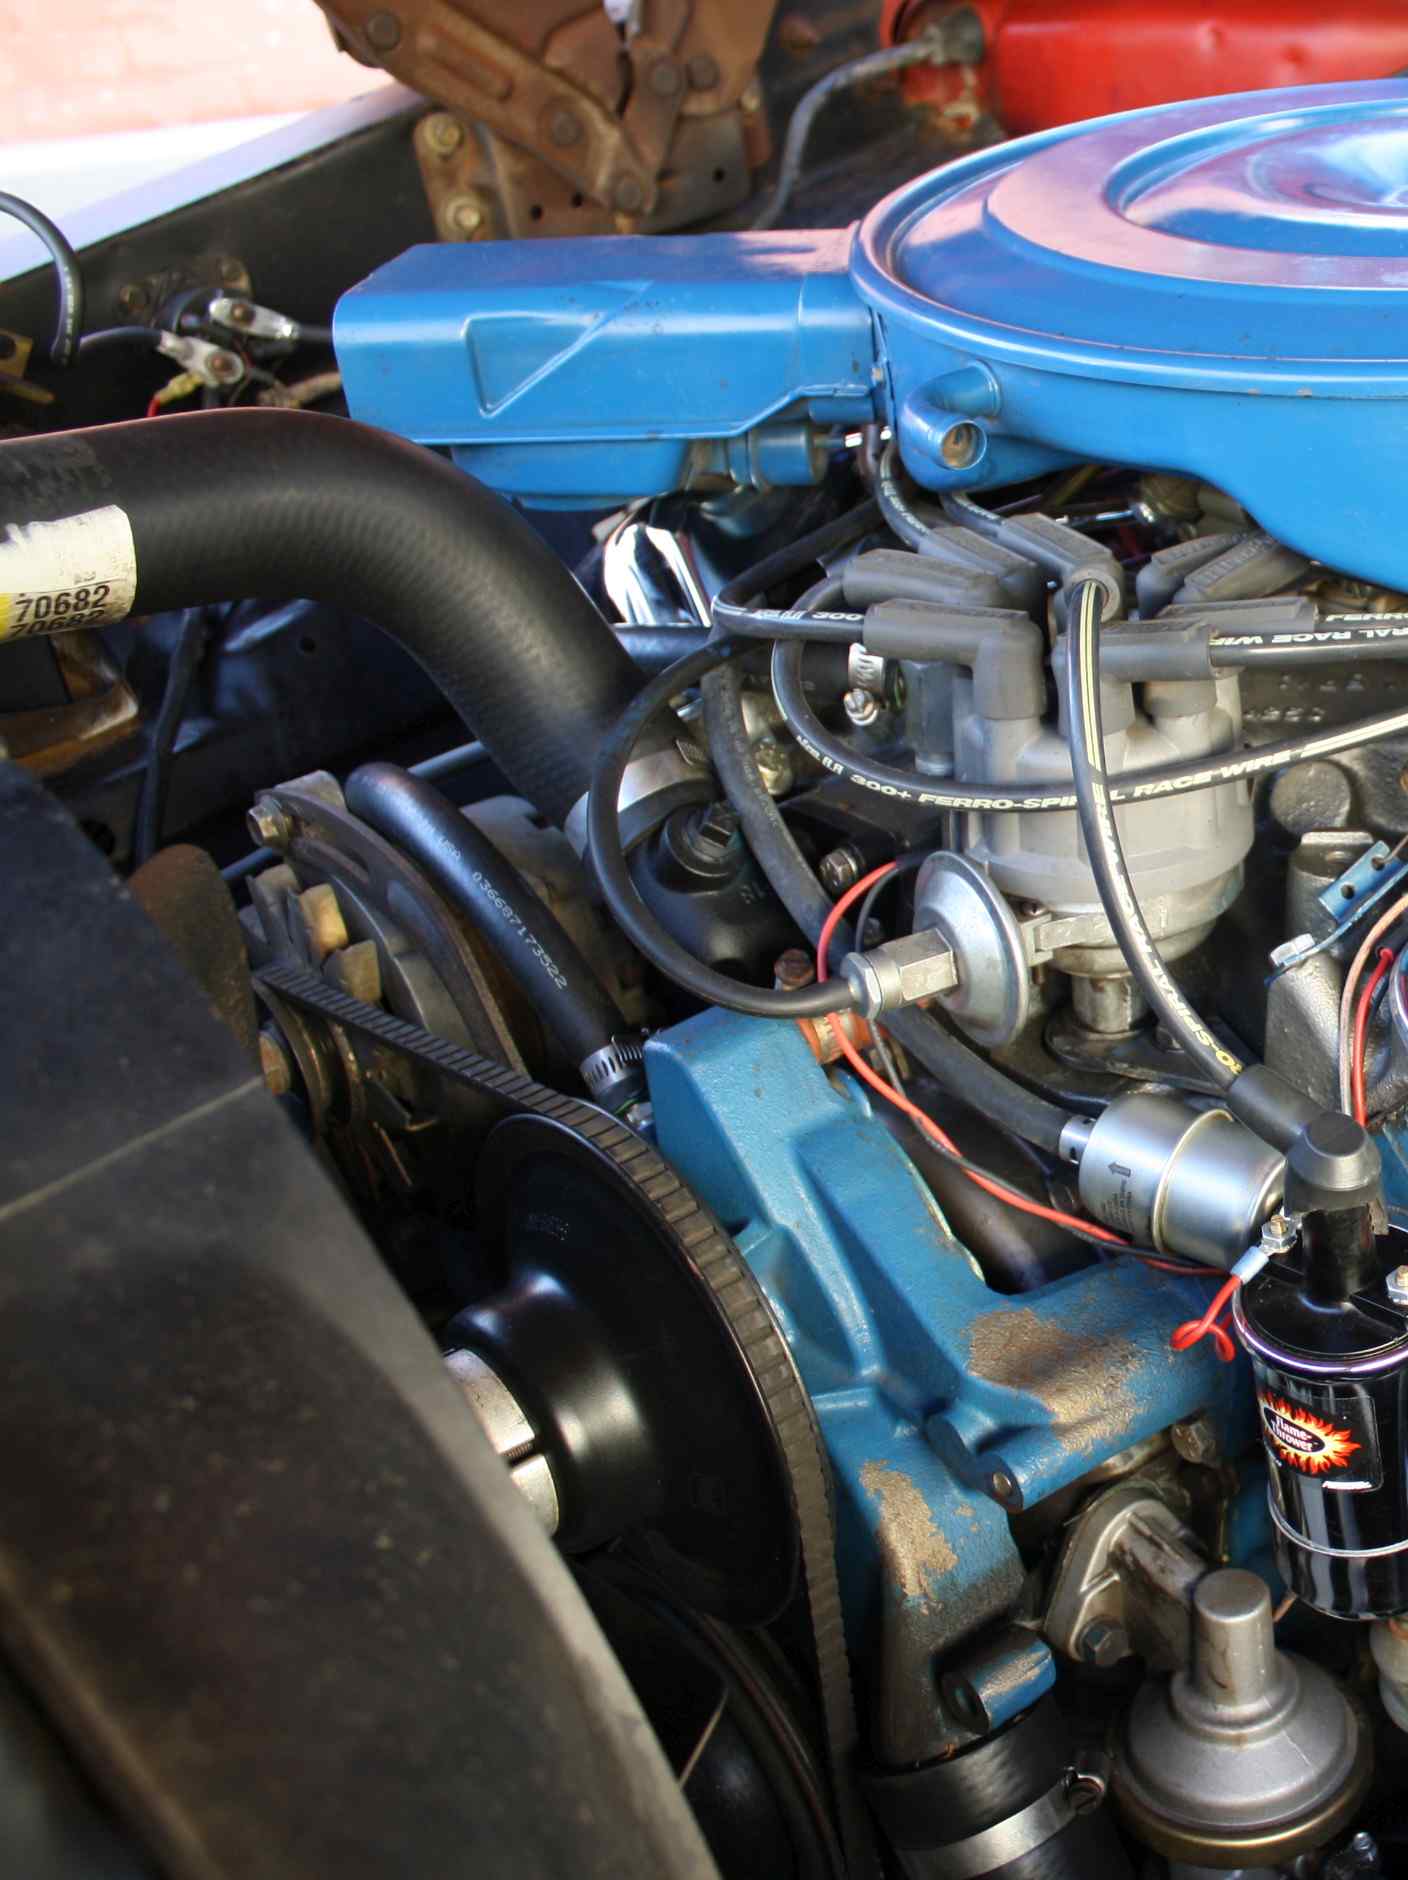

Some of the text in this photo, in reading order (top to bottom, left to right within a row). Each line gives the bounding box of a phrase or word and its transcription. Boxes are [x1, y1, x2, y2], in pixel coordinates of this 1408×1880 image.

[15, 584, 110, 622] 70682
[1271, 632, 1351, 644] RACE
[850, 750, 1291, 809] 300+ FERRO-SPIL RACE WIRE
[1274, 1414, 1313, 1441] Flame-
